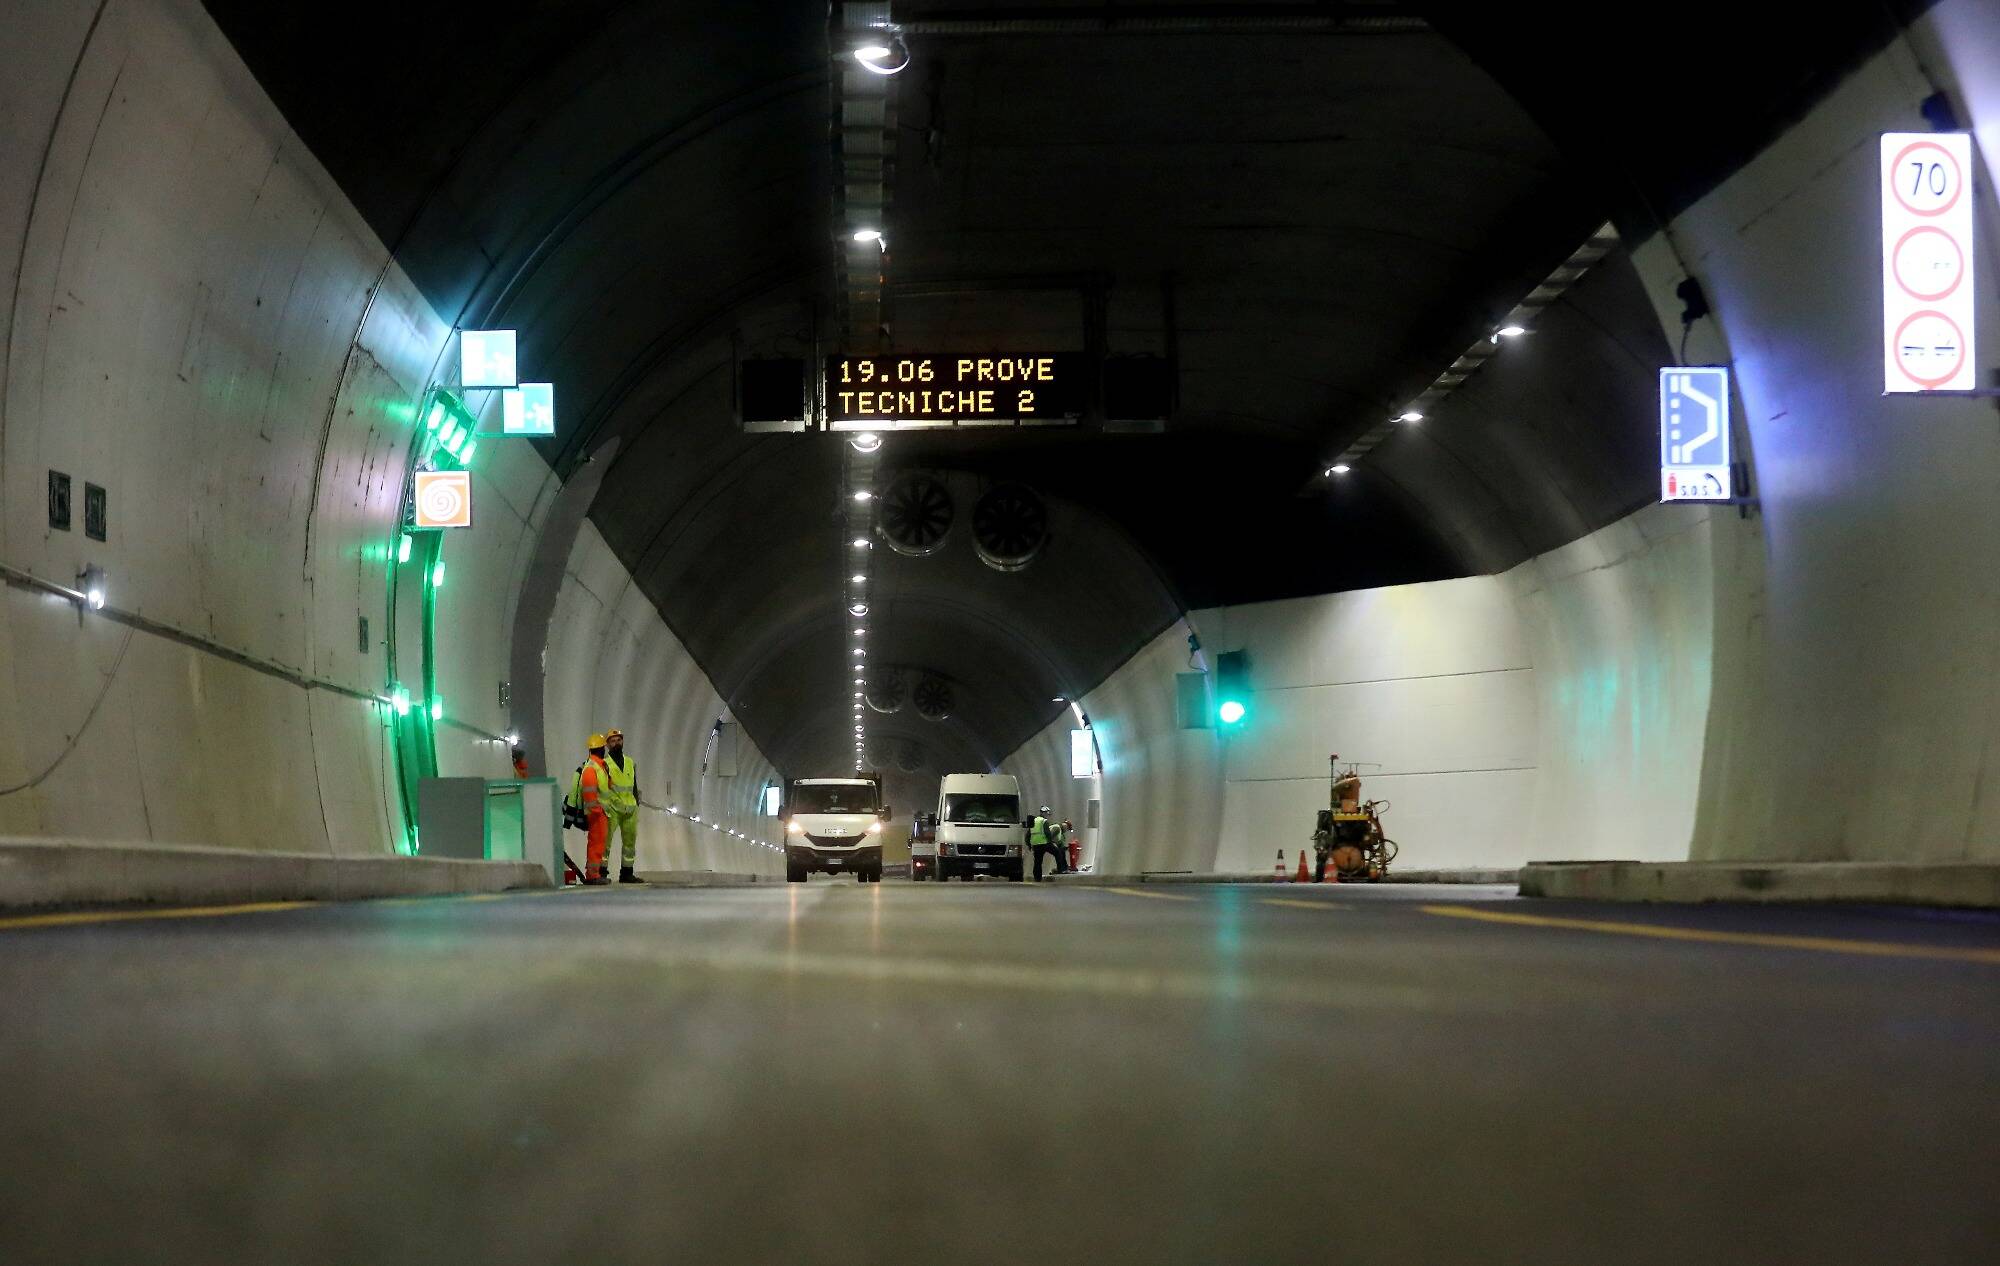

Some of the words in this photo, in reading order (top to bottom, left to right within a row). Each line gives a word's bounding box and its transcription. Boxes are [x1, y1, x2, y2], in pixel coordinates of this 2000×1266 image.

[1911, 162, 1947, 196] 70
[839, 359, 935, 383] 19.06
[957, 358, 1054, 381] PROVE
[838, 390, 995, 414] TECNICHE
[1017, 390, 1035, 413] 2
